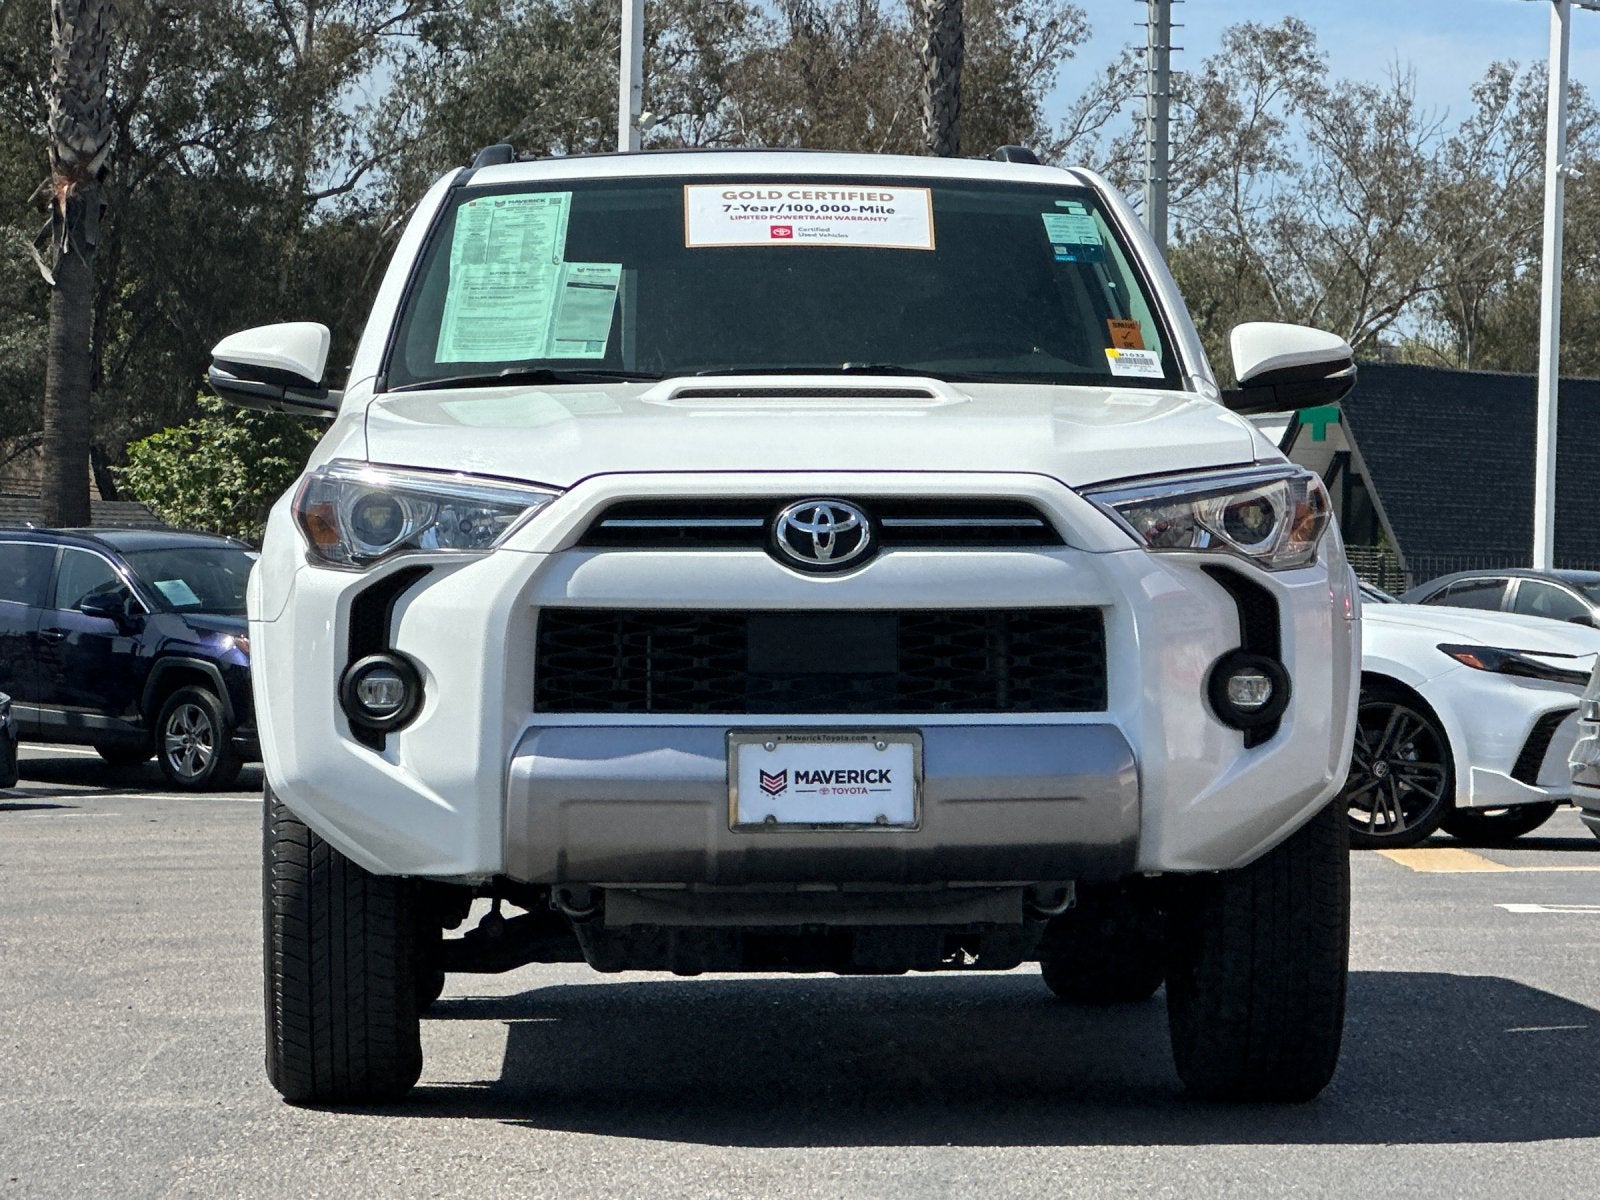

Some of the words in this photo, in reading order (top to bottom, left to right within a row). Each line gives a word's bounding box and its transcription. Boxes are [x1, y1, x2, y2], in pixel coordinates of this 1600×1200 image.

[722, 190, 783, 201] GOLD
[787, 190, 895, 202] CERTIFIED
[722, 204, 895, 214] 7-Year/100,000-Mile
[785, 734, 869, 743] MaverickToyota.com
[794, 769, 892, 785] MAVERICK
[832, 787, 869, 795] TOYOTA
